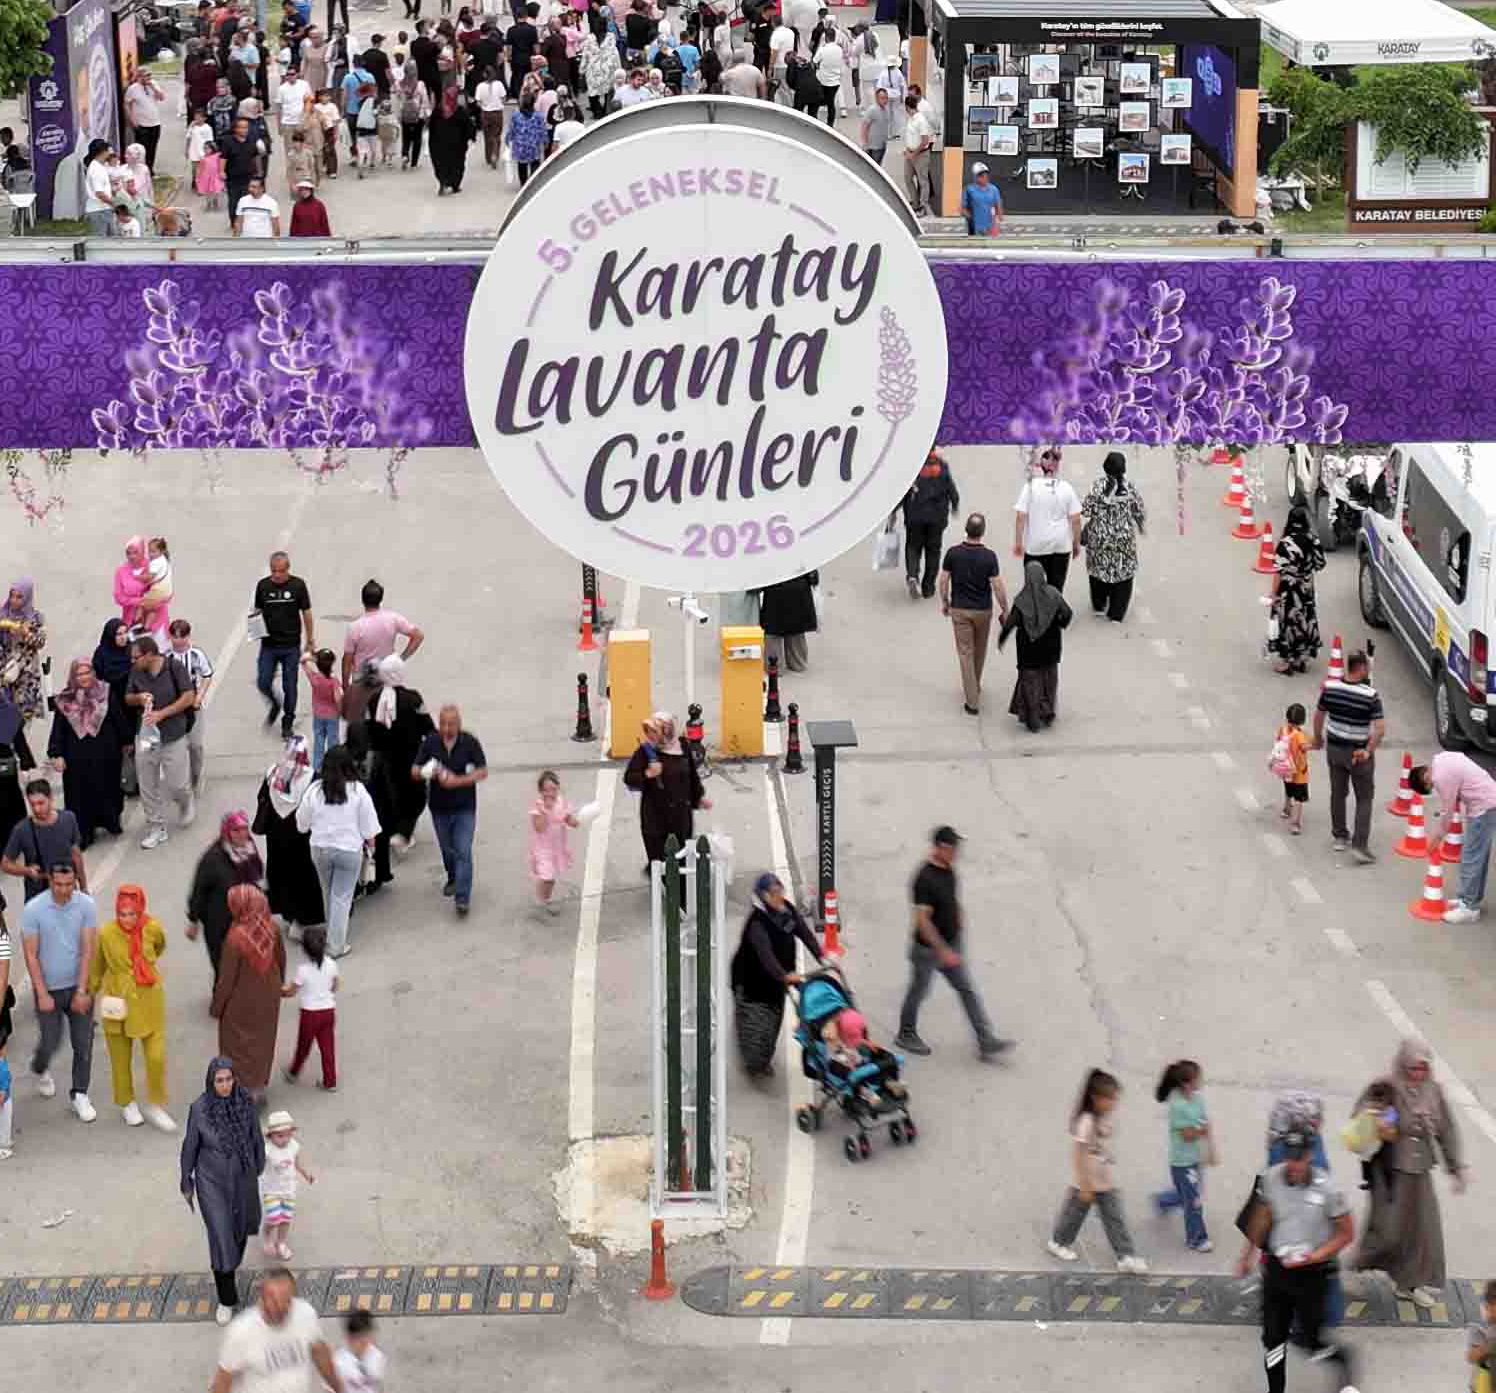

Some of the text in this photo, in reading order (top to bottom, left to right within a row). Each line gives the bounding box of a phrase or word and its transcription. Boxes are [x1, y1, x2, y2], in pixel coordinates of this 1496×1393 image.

[1377, 42, 1421, 55] KARATAY
[1355, 209, 1413, 222] KARATAY
[588, 233, 882, 332] Karatay
[493, 313, 829, 436] Lavanta
[584, 403, 865, 522] Günleri
[680, 514, 796, 559] 2026
